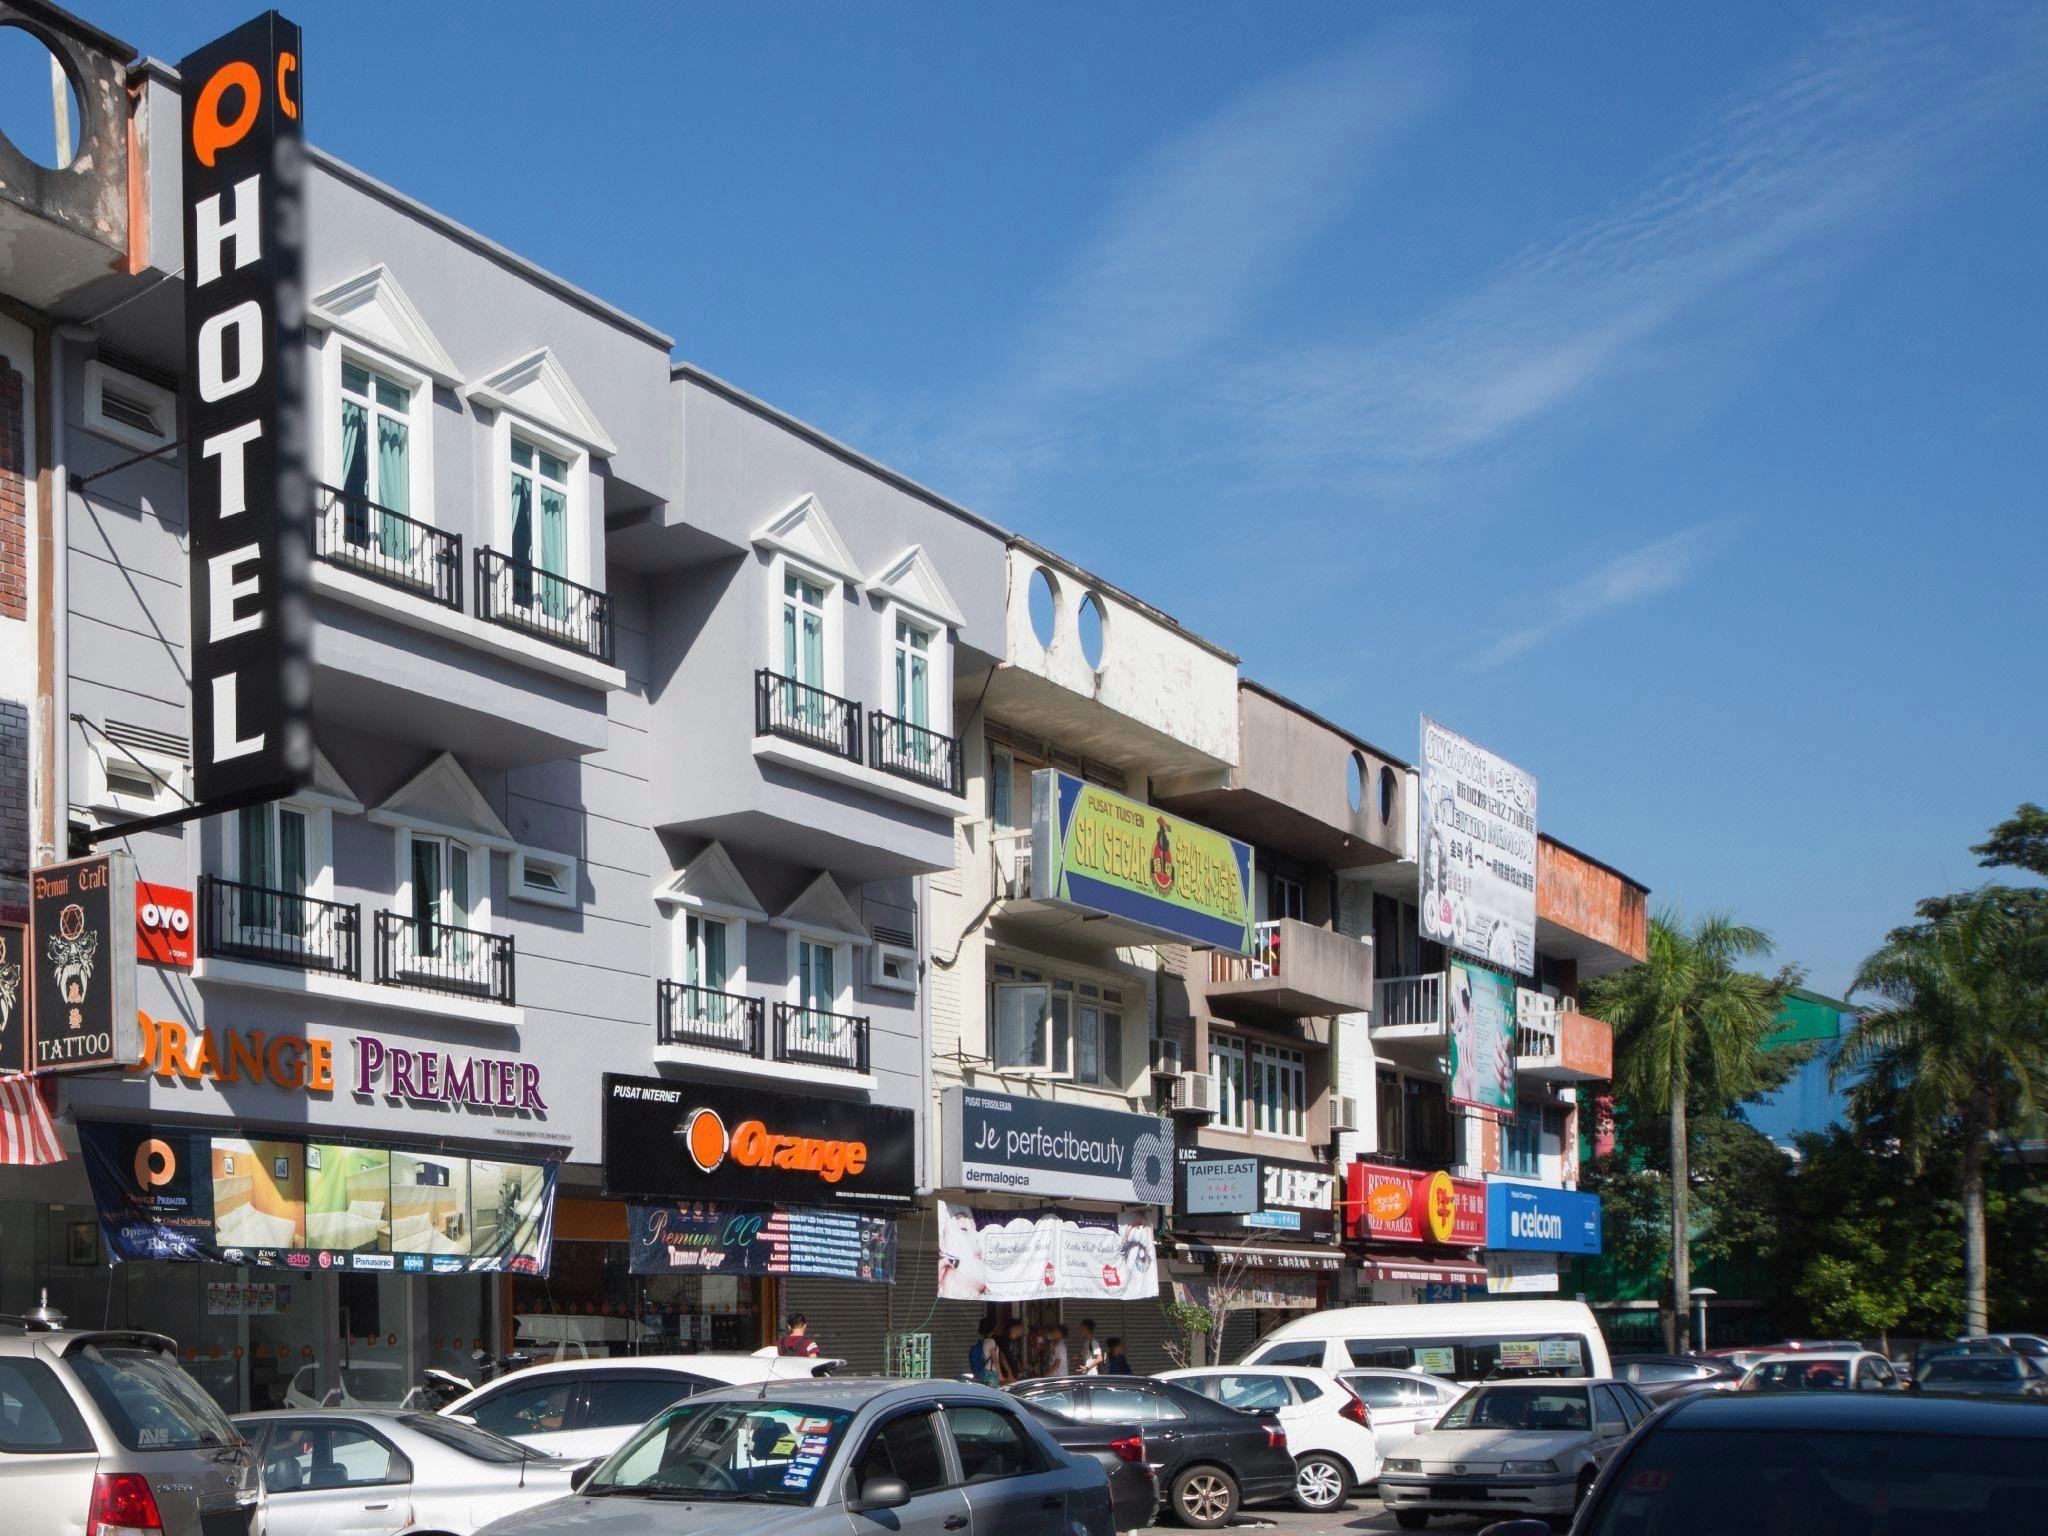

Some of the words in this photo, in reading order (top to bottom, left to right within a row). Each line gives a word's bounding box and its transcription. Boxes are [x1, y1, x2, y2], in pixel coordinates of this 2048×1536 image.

[196, 173, 265, 764] HOTEL
[1427, 730, 1486, 788] SINGAPORE
[1088, 795, 1114, 816] PUSAT
[1115, 805, 1144, 828] TUISYEN
[1075, 816, 1099, 870] SRI
[1103, 824, 1150, 887] SEGAR
[78, 864, 108, 891] Craft
[141, 904, 189, 932] OYO
[39, 1032, 110, 1061] TATTOO
[355, 1036, 549, 1111] PREMIER
[613, 1085, 639, 1100] PUSAT
[641, 1088, 681, 1103] INTERNET
[965, 1096, 980, 1108] PUSAT
[731, 1119, 867, 1183] Orange
[975, 1120, 1001, 1150] Je
[1007, 1125, 1125, 1173] perfectbeauty
[966, 1168, 1030, 1186] dermalogica
[1190, 1163, 1255, 1176] TAIPEI.EAST
[157, 1196, 187, 1205] PREMIER
[643, 1209, 717, 1246] Premium
[722, 1214, 762, 1246] CC
[1520, 1204, 1562, 1240] celcom
[288, 1253, 310, 1264] astro
[333, 1255, 344, 1265] LG
[355, 1257, 392, 1267] Panasonic
[1432, 1284, 1453, 1300] 24
